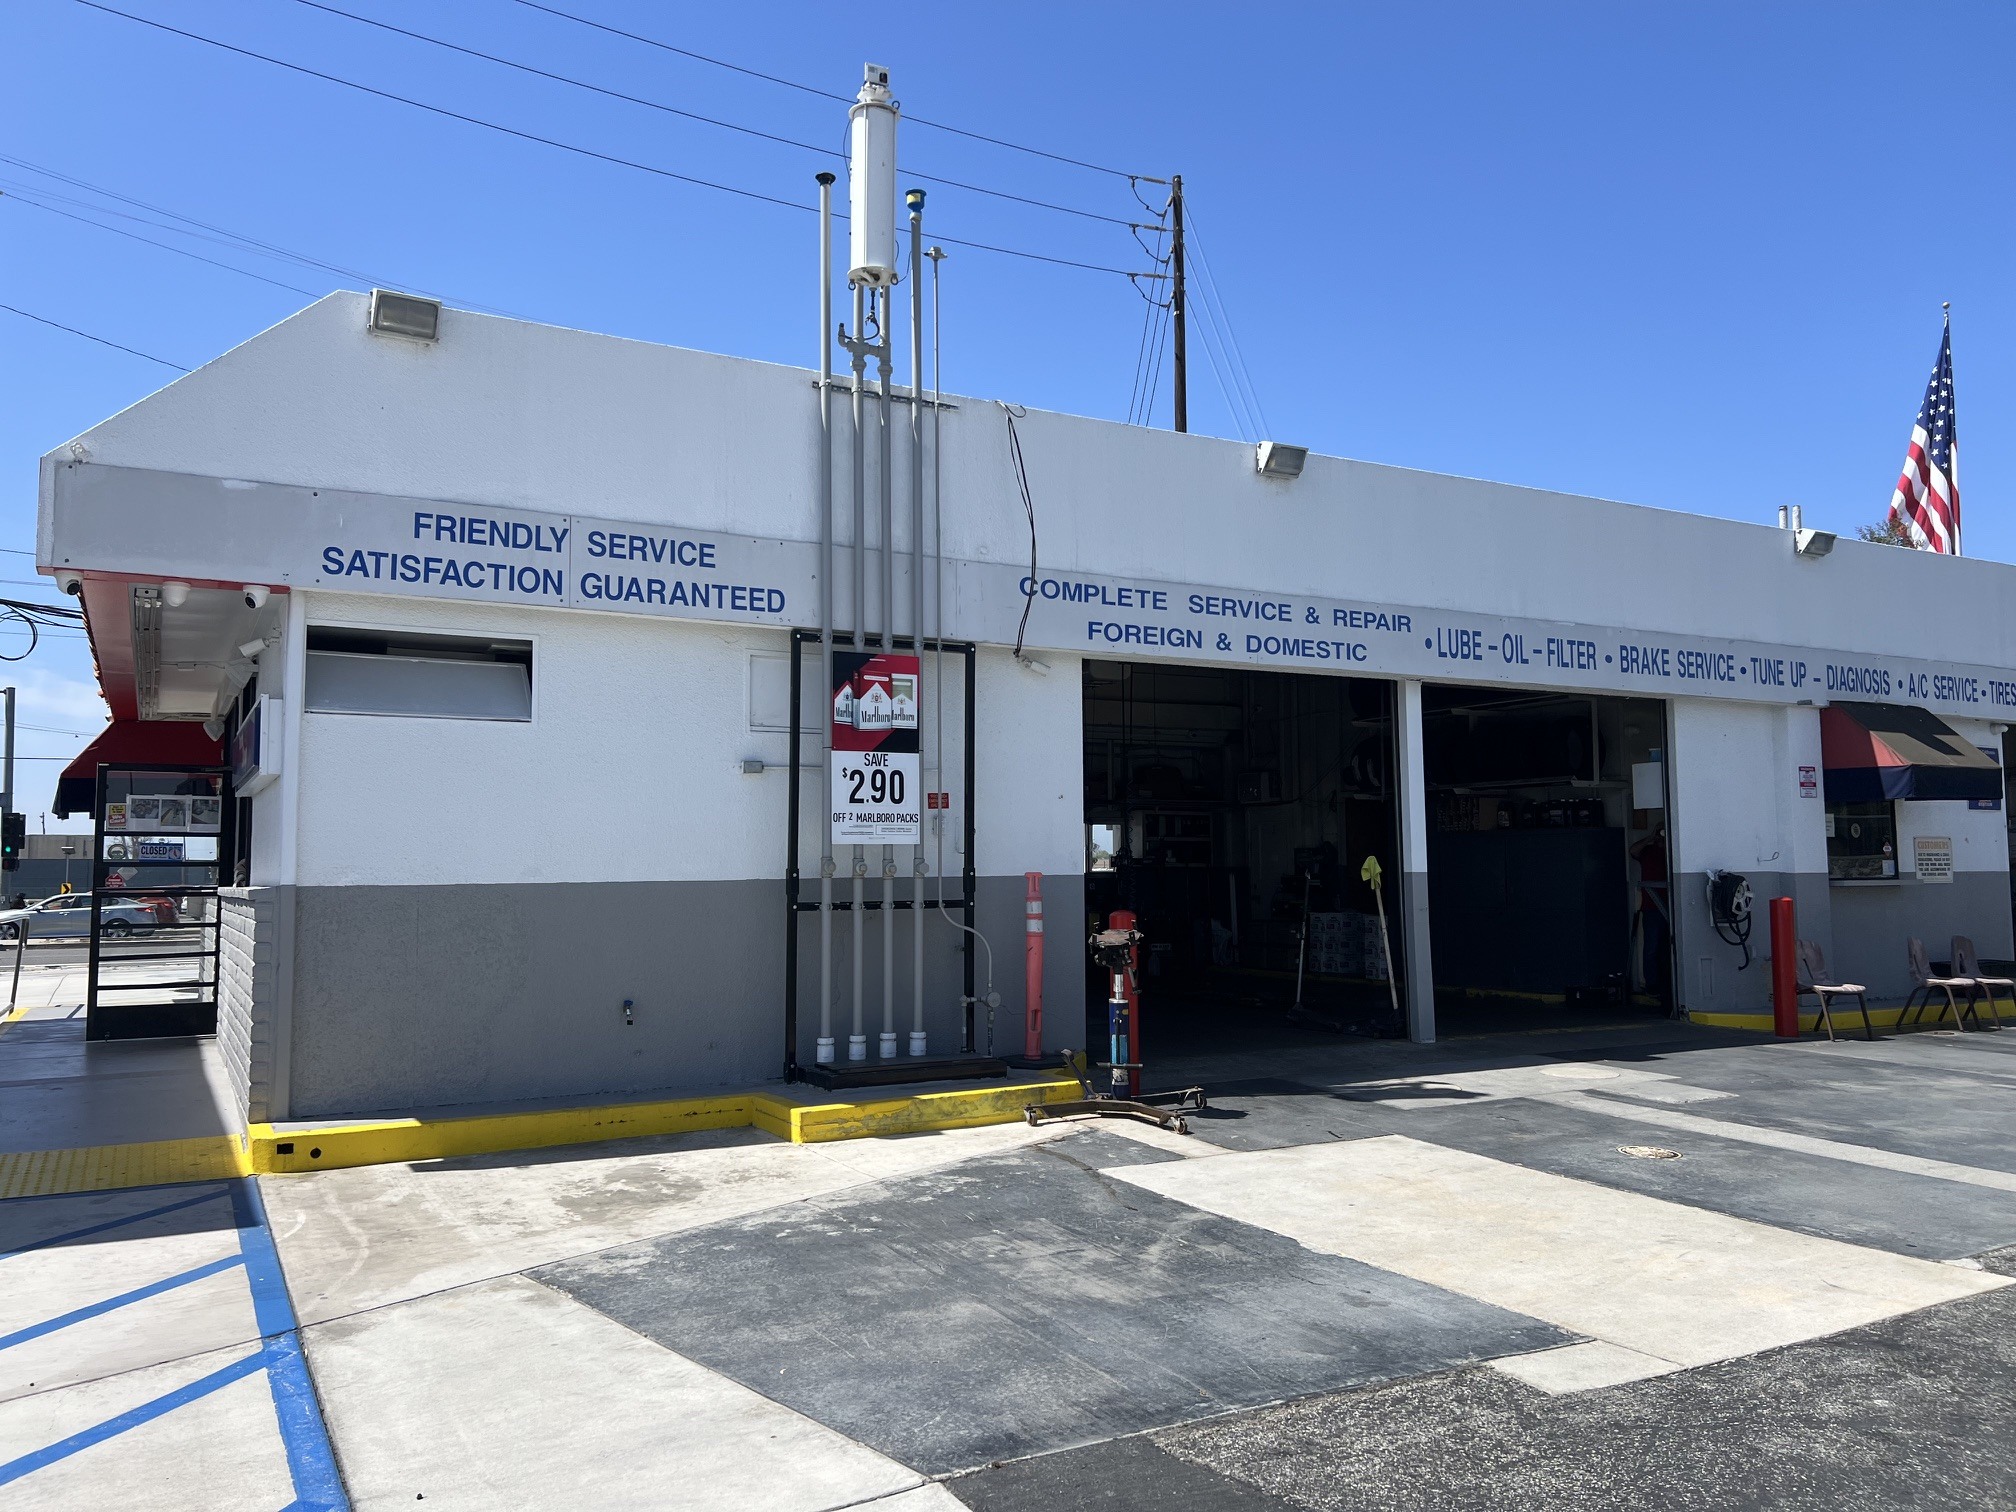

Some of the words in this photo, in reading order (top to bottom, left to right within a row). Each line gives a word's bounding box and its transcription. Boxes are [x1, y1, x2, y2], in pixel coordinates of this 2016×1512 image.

[414, 511, 568, 554] FRIENDLY
[587, 530, 716, 569] SERVICE
[322, 547, 563, 596] SATISFACTION
[581, 572, 785, 614] GUARANTEED
[1019, 576, 1167, 611] COMPLETE
[1189, 594, 1293, 623] SERVICE
[1304, 606, 1321, 625] &
[1332, 608, 1412, 634] REPAIR
[1088, 620, 1203, 650] FOREIGN
[1215, 632, 1232, 652] &
[1245, 634, 1368, 662] DOMESTIC
[1437, 626, 1483, 662] LUBE
[1501, 632, 1530, 665] OIL
[1546, 637, 1597, 671] FILTER
[1620, 644, 1671, 677] BRAKE
[1677, 649, 1736, 683] SERVICE
[1749, 656, 1786, 687] TUNE
[1790, 660, 1809, 688] UP
[1824, 663, 1891, 697] DIAGNOSIS
[1908, 672, 1929, 700] A/C
[1933, 675, 1979, 703] SERVICE
[861, 705, 891, 723] Marlboro
[864, 753, 889, 767] SAVE
[842, 766, 905, 805] $2.90
[832, 812, 847, 823] OFF
[848, 812, 854, 821] 2
[856, 812, 896, 823] MARLBORO
[896, 813, 919, 823] PACKS
[141, 846, 168, 855] CLOSED
[1917, 841, 1950, 850] CUSTOMERS
